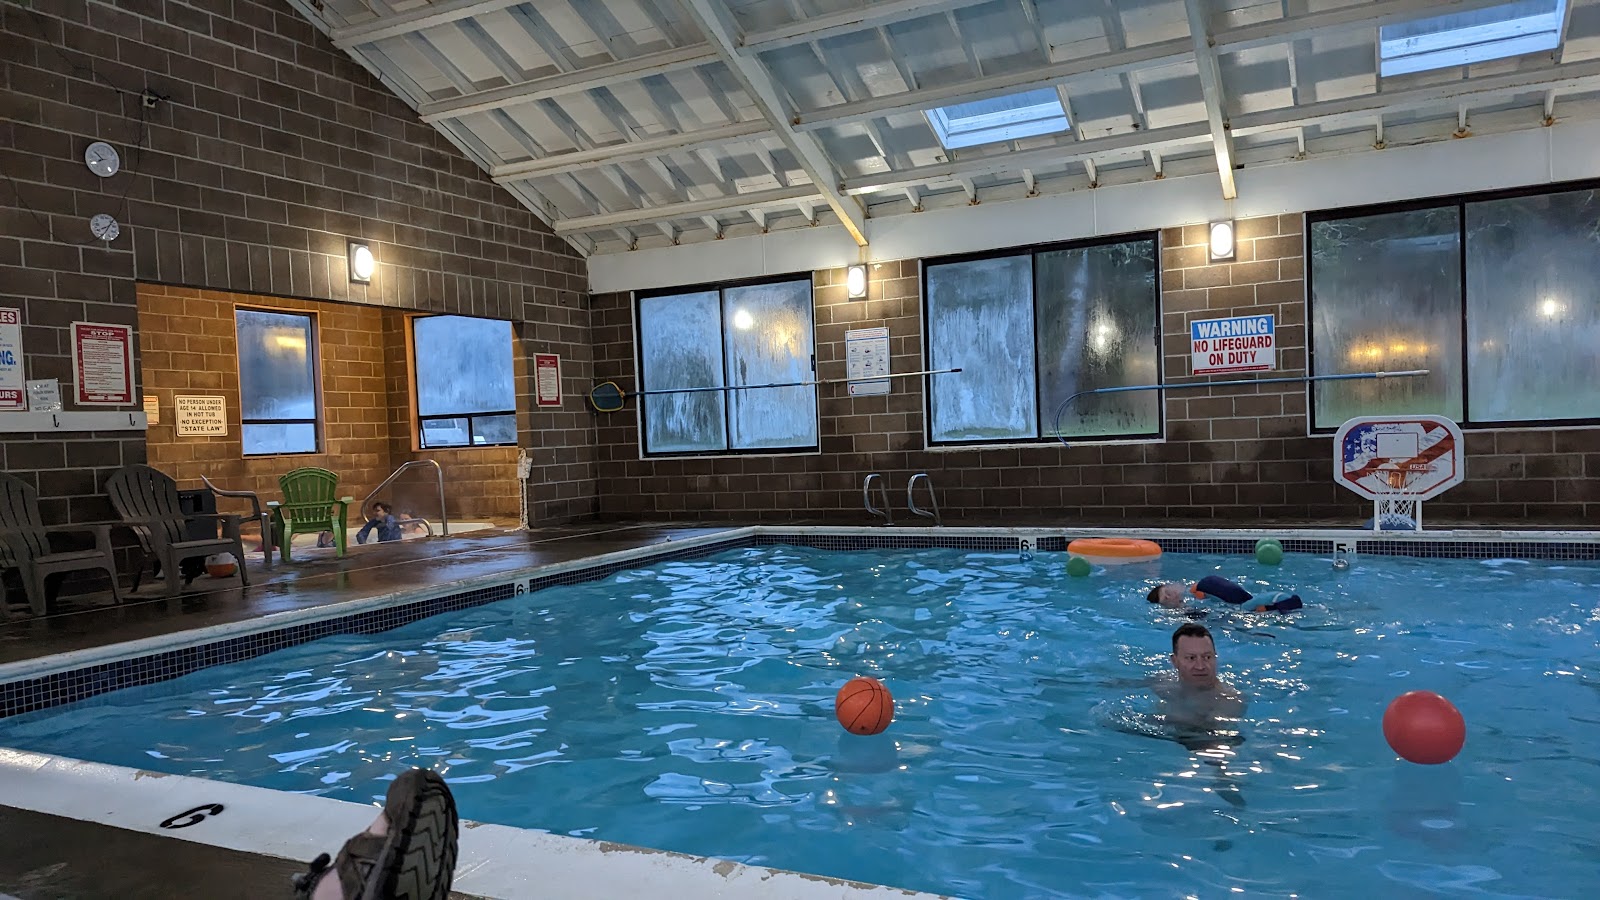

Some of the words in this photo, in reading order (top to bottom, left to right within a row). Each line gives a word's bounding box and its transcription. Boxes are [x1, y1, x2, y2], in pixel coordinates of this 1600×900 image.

[1197, 318, 1268, 338] WARNING
[1194, 340, 1208, 353] NO
[1213, 336, 1272, 351] LIFEGUARD
[1209, 353, 1223, 365] ON
[1228, 351, 1256, 364] DUTY
[1021, 539, 1029, 550] 6
[1336, 543, 1346, 553] 5
[517, 584, 524, 595] 6
[159, 803, 224, 829] 6
